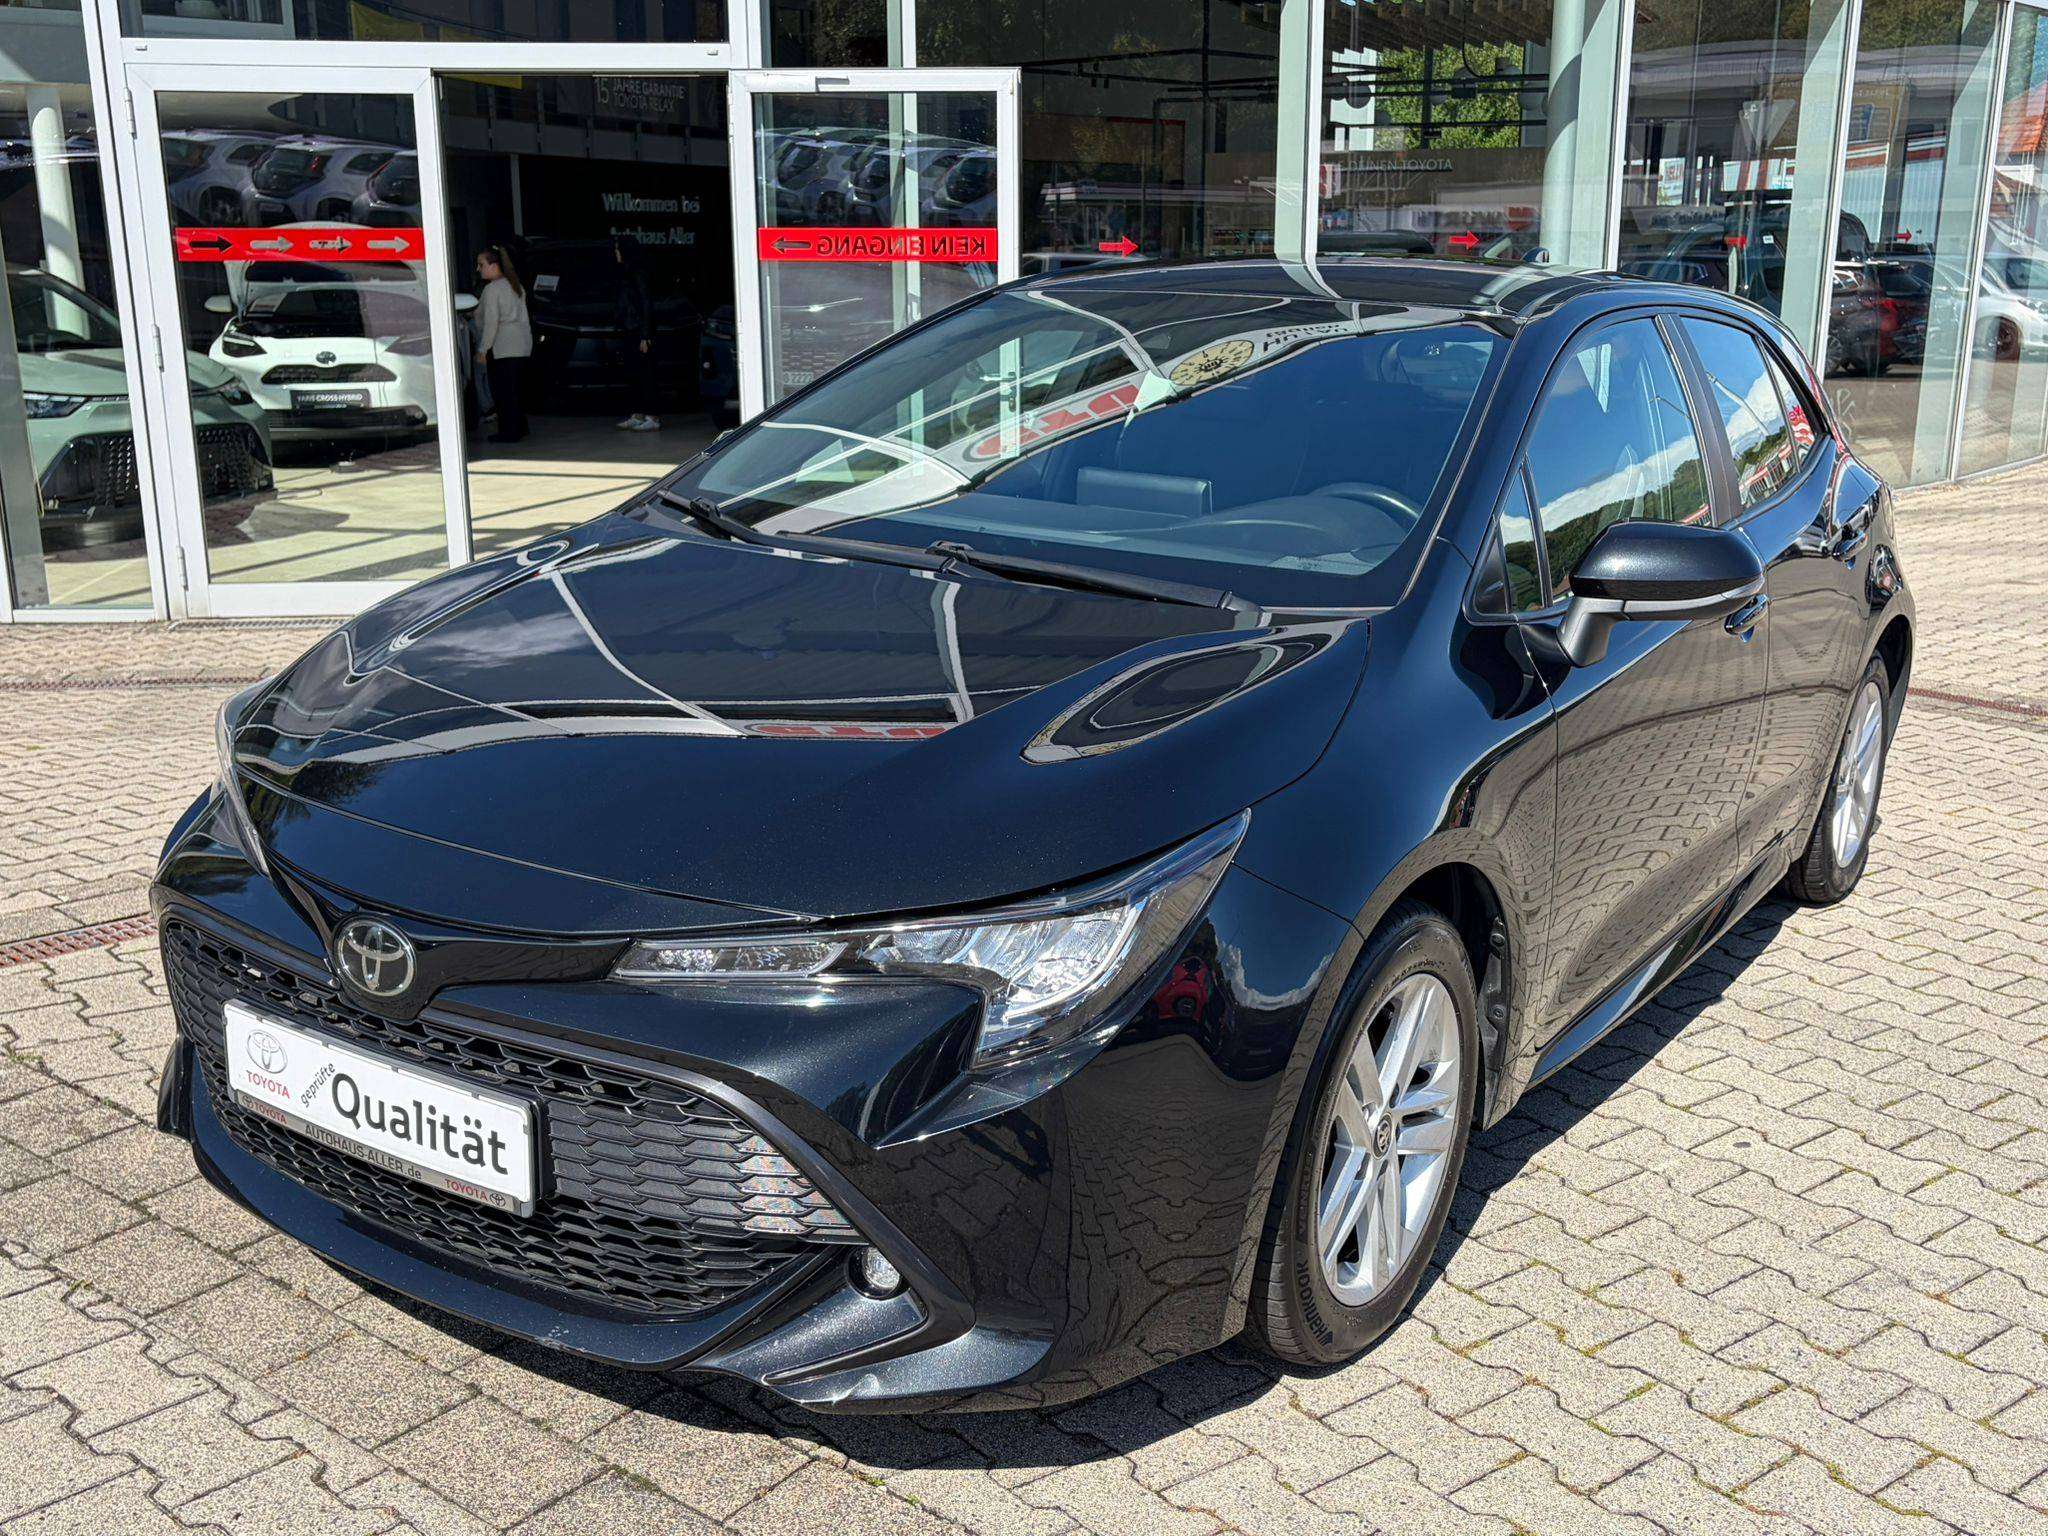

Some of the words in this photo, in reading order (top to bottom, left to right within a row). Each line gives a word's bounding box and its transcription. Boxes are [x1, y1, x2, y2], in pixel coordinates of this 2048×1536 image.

[593, 77, 610, 103] 15
[613, 78, 641, 94] JAHRE
[642, 81, 685, 99] GARANTIE
[613, 92, 647, 109] TOYOTA
[650, 97, 674, 112] RELAX
[1401, 158, 1453, 170] TOYOTA
[601, 192, 678, 213] Willkommen
[681, 195, 701, 213] bei
[668, 227, 696, 245] Aller
[246, 1070, 291, 1099] TOYOTA
[301, 1062, 336, 1108] geprüfte
[254, 1103, 288, 1124] TOYOTA
[331, 1073, 509, 1175] Qualität
[444, 1178, 488, 1201] TOYOTA
